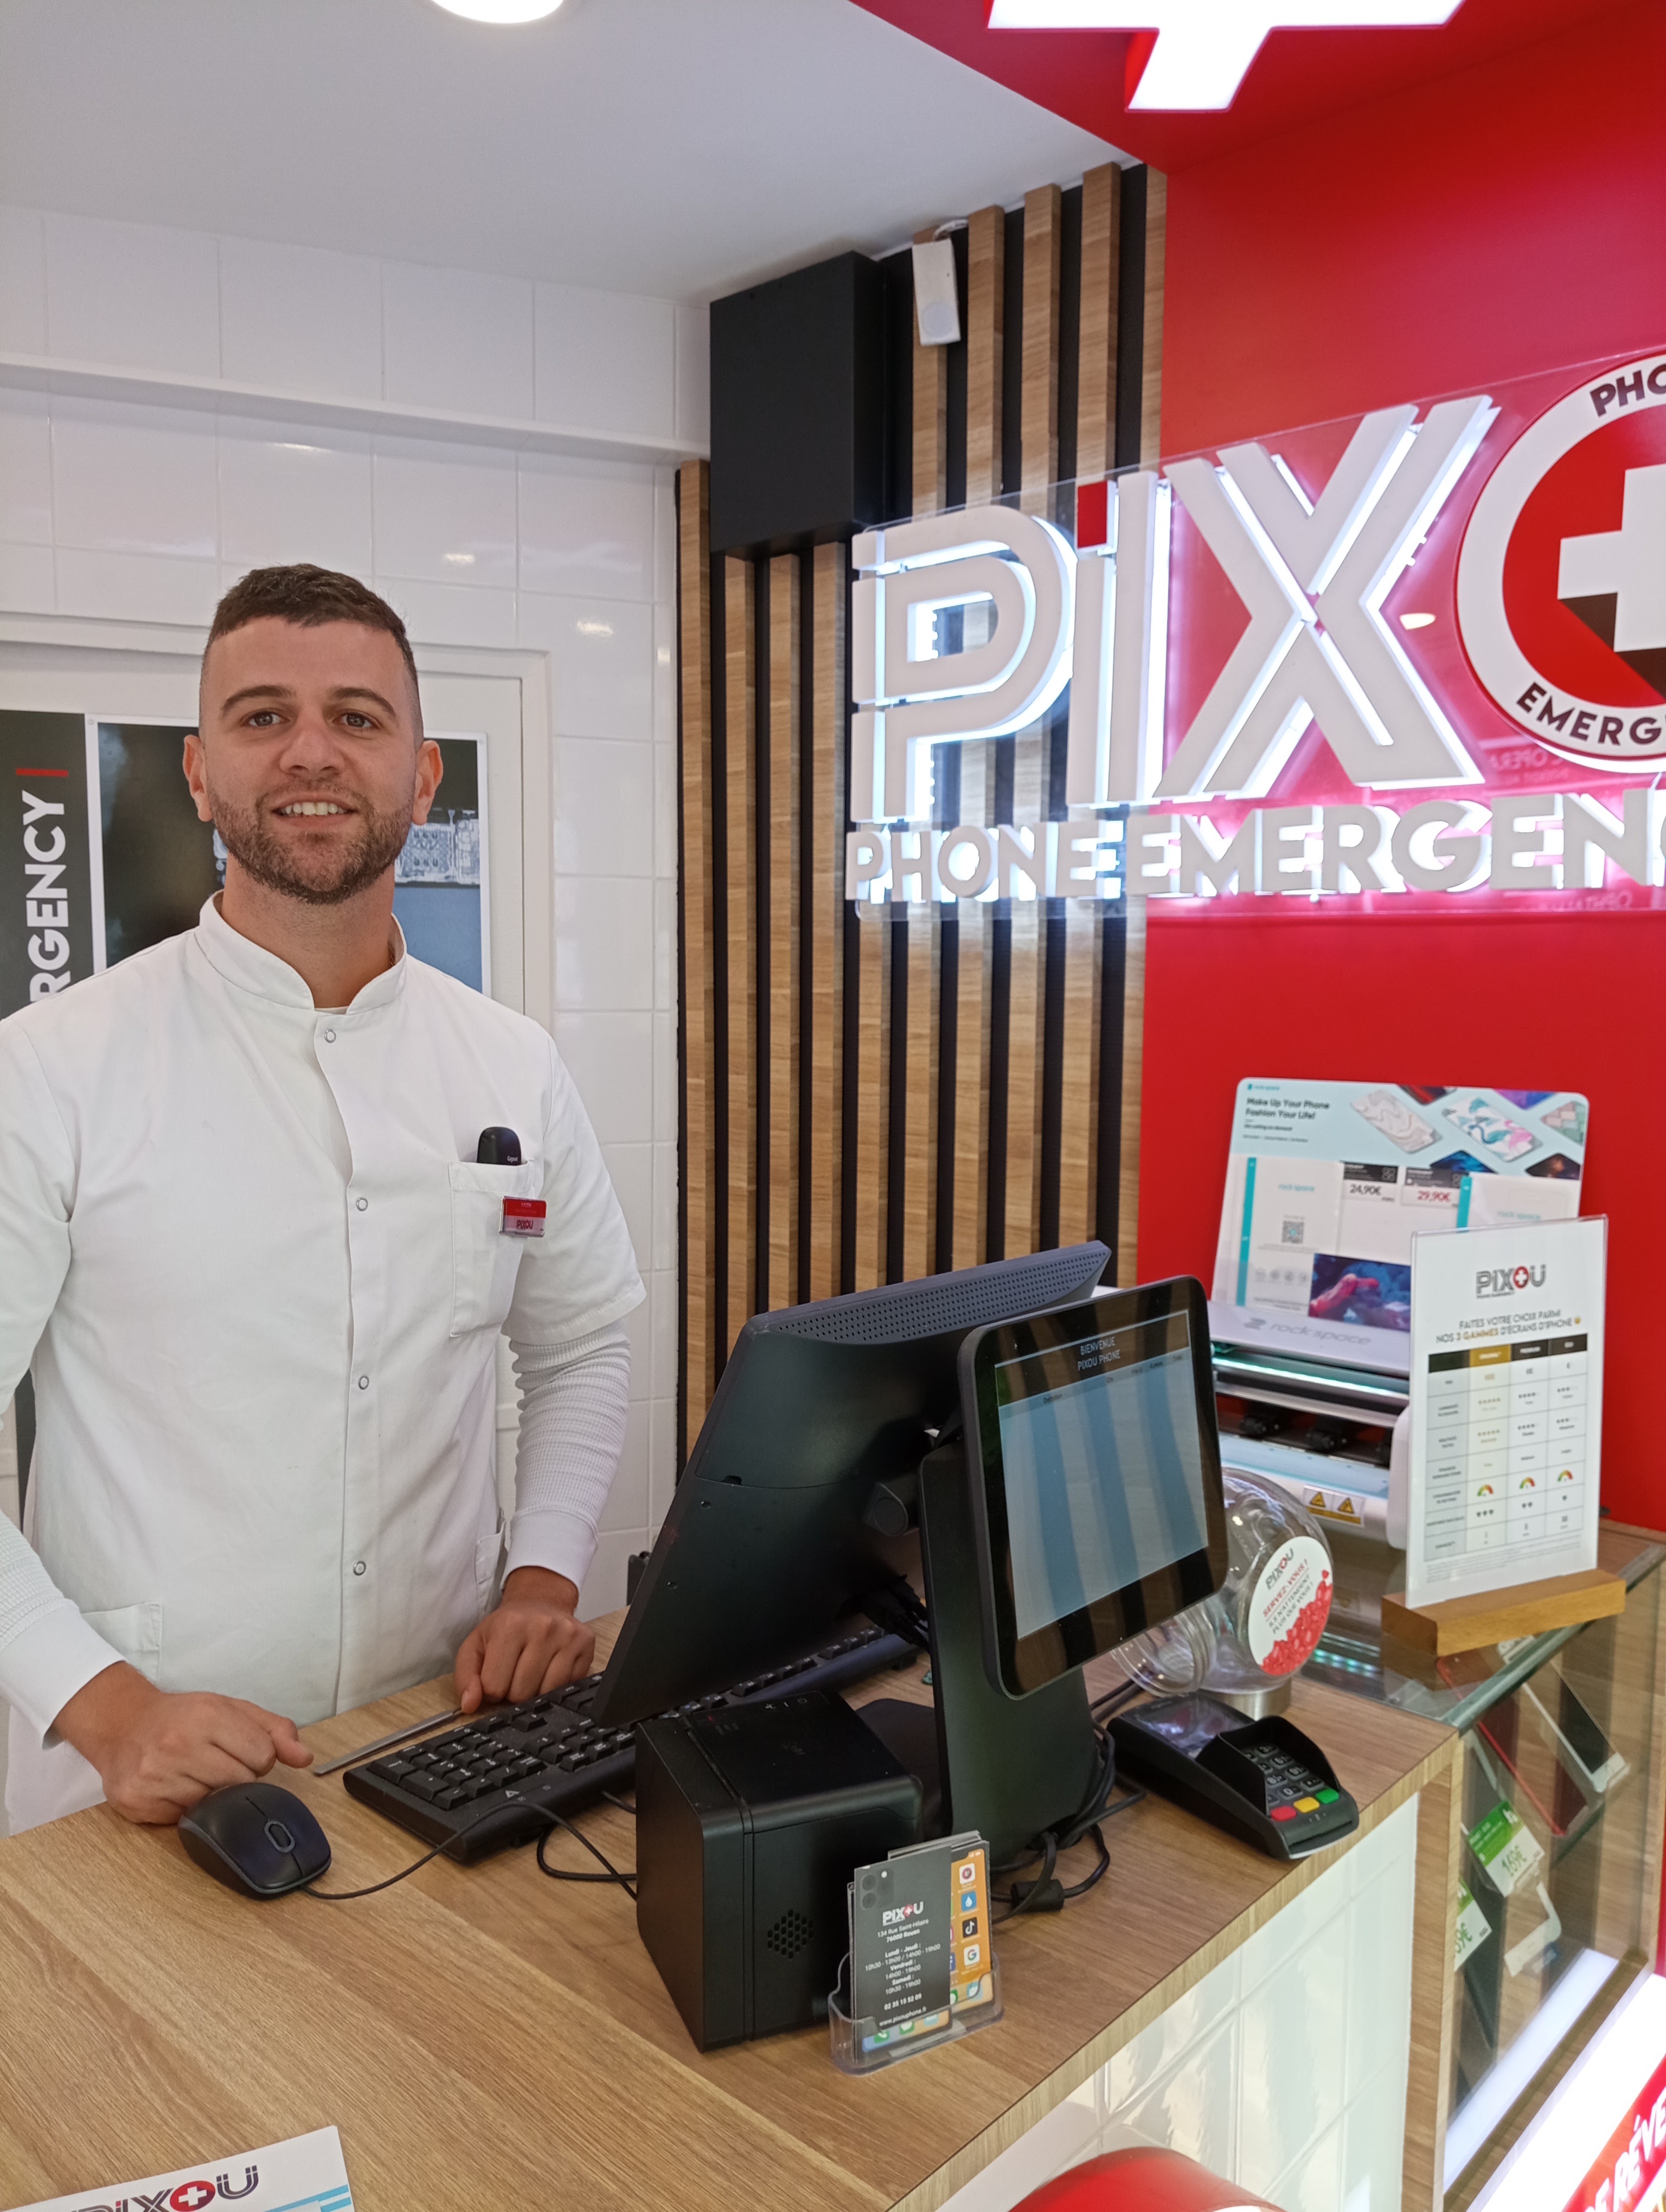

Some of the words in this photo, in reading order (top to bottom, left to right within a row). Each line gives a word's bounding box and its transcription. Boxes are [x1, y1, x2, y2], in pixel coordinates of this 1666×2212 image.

[1516, 681, 1666, 745] EMERG
[845, 820, 1109, 902] PHONE
[1126, 788, 1666, 898] EMERGEN
[21, 790, 71, 1002] RGENCY
[1247, 1097, 1268, 1106] Make
[1270, 1098, 1281, 1108] Up
[1283, 1098, 1302, 1108] Your
[1304, 1099, 1330, 1110] Phone
[1245, 1108, 1276, 1117] Fashion
[1278, 1110, 1297, 1118] Your
[1349, 1183, 1382, 1196] 24,90€
[1417, 1189, 1452, 1202] 29,90€
[1476, 1264, 1546, 1294] PIXOU
[1486, 1315, 1511, 1327] VOTRE
[1271, 1323, 1311, 1336] rock
[1312, 1330, 1372, 1345] space
[1080, 1336, 1116, 1355] BIENVENUE
[1078, 1357, 1098, 1371] PIXOU
[1099, 1349, 1122, 1366] PHONE
[877, 1930, 887, 1938] 134
[886, 1932, 903, 1943] 76000
[904, 1928, 920, 1938] Rouen
[885, 1948, 900, 1958] Lundi
[904, 1943, 918, 1953] Jeudi
[865, 1961, 881, 1971] 10h30
[890, 1959, 913, 1971] Vendredi
[892, 1974, 912, 1985] Samedi
